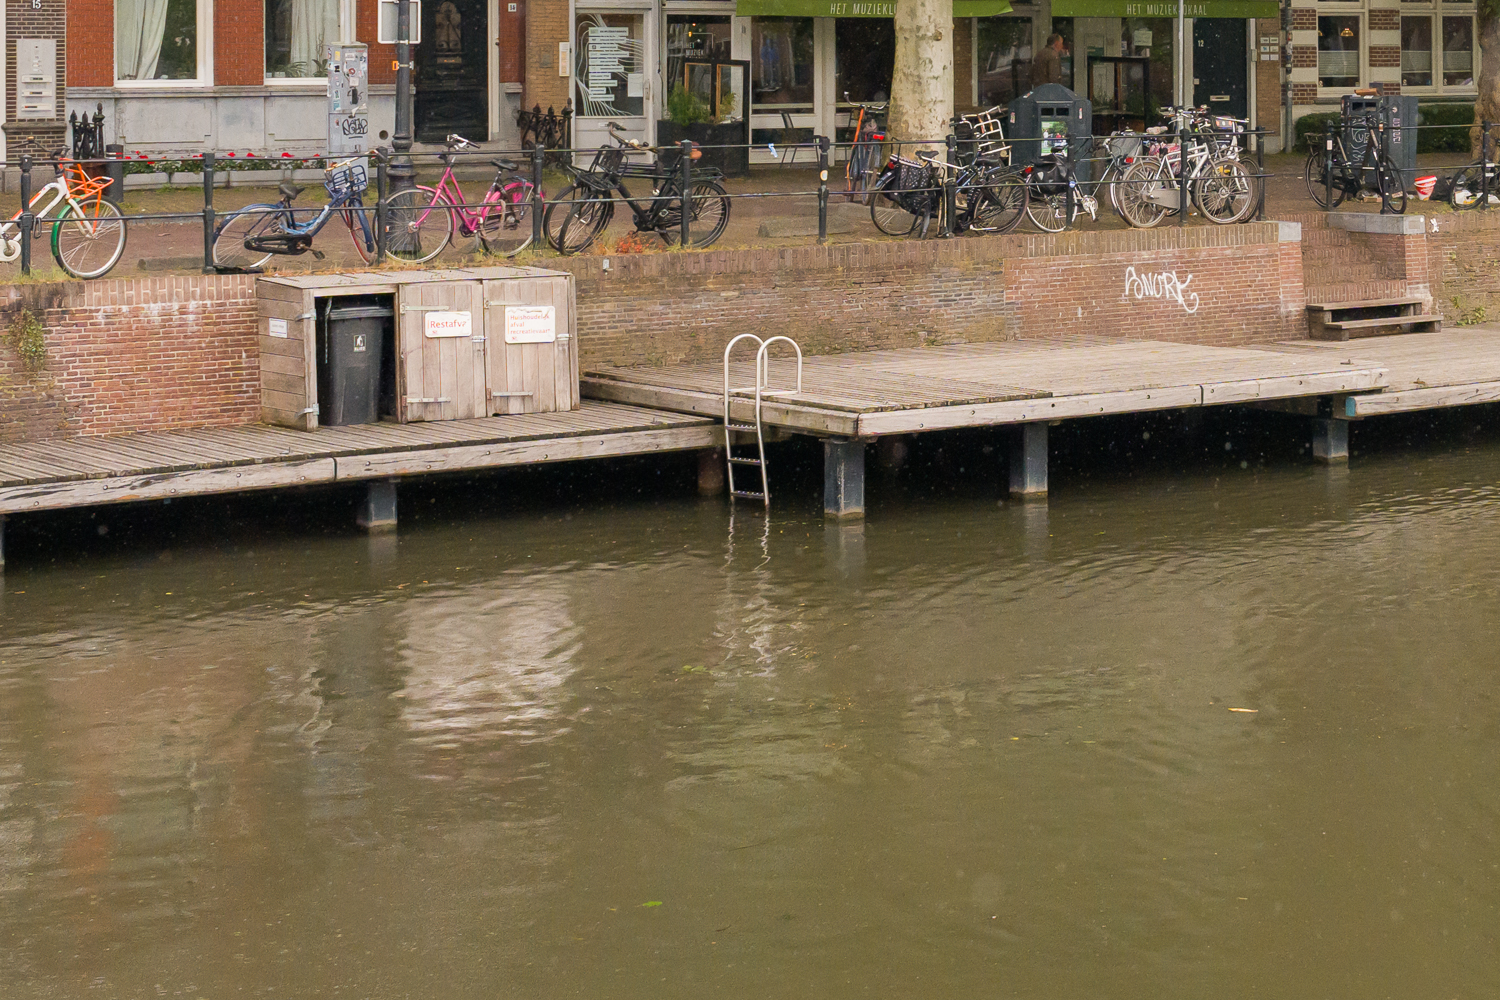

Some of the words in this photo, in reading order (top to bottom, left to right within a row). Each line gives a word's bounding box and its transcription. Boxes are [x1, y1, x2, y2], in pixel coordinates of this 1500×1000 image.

[32, 0, 42, 10] 15
[830, 3, 847, 15] HET
[1126, 3, 1141, 15] HET
[1146, 4, 1207, 16] MUZIEKOKAAL
